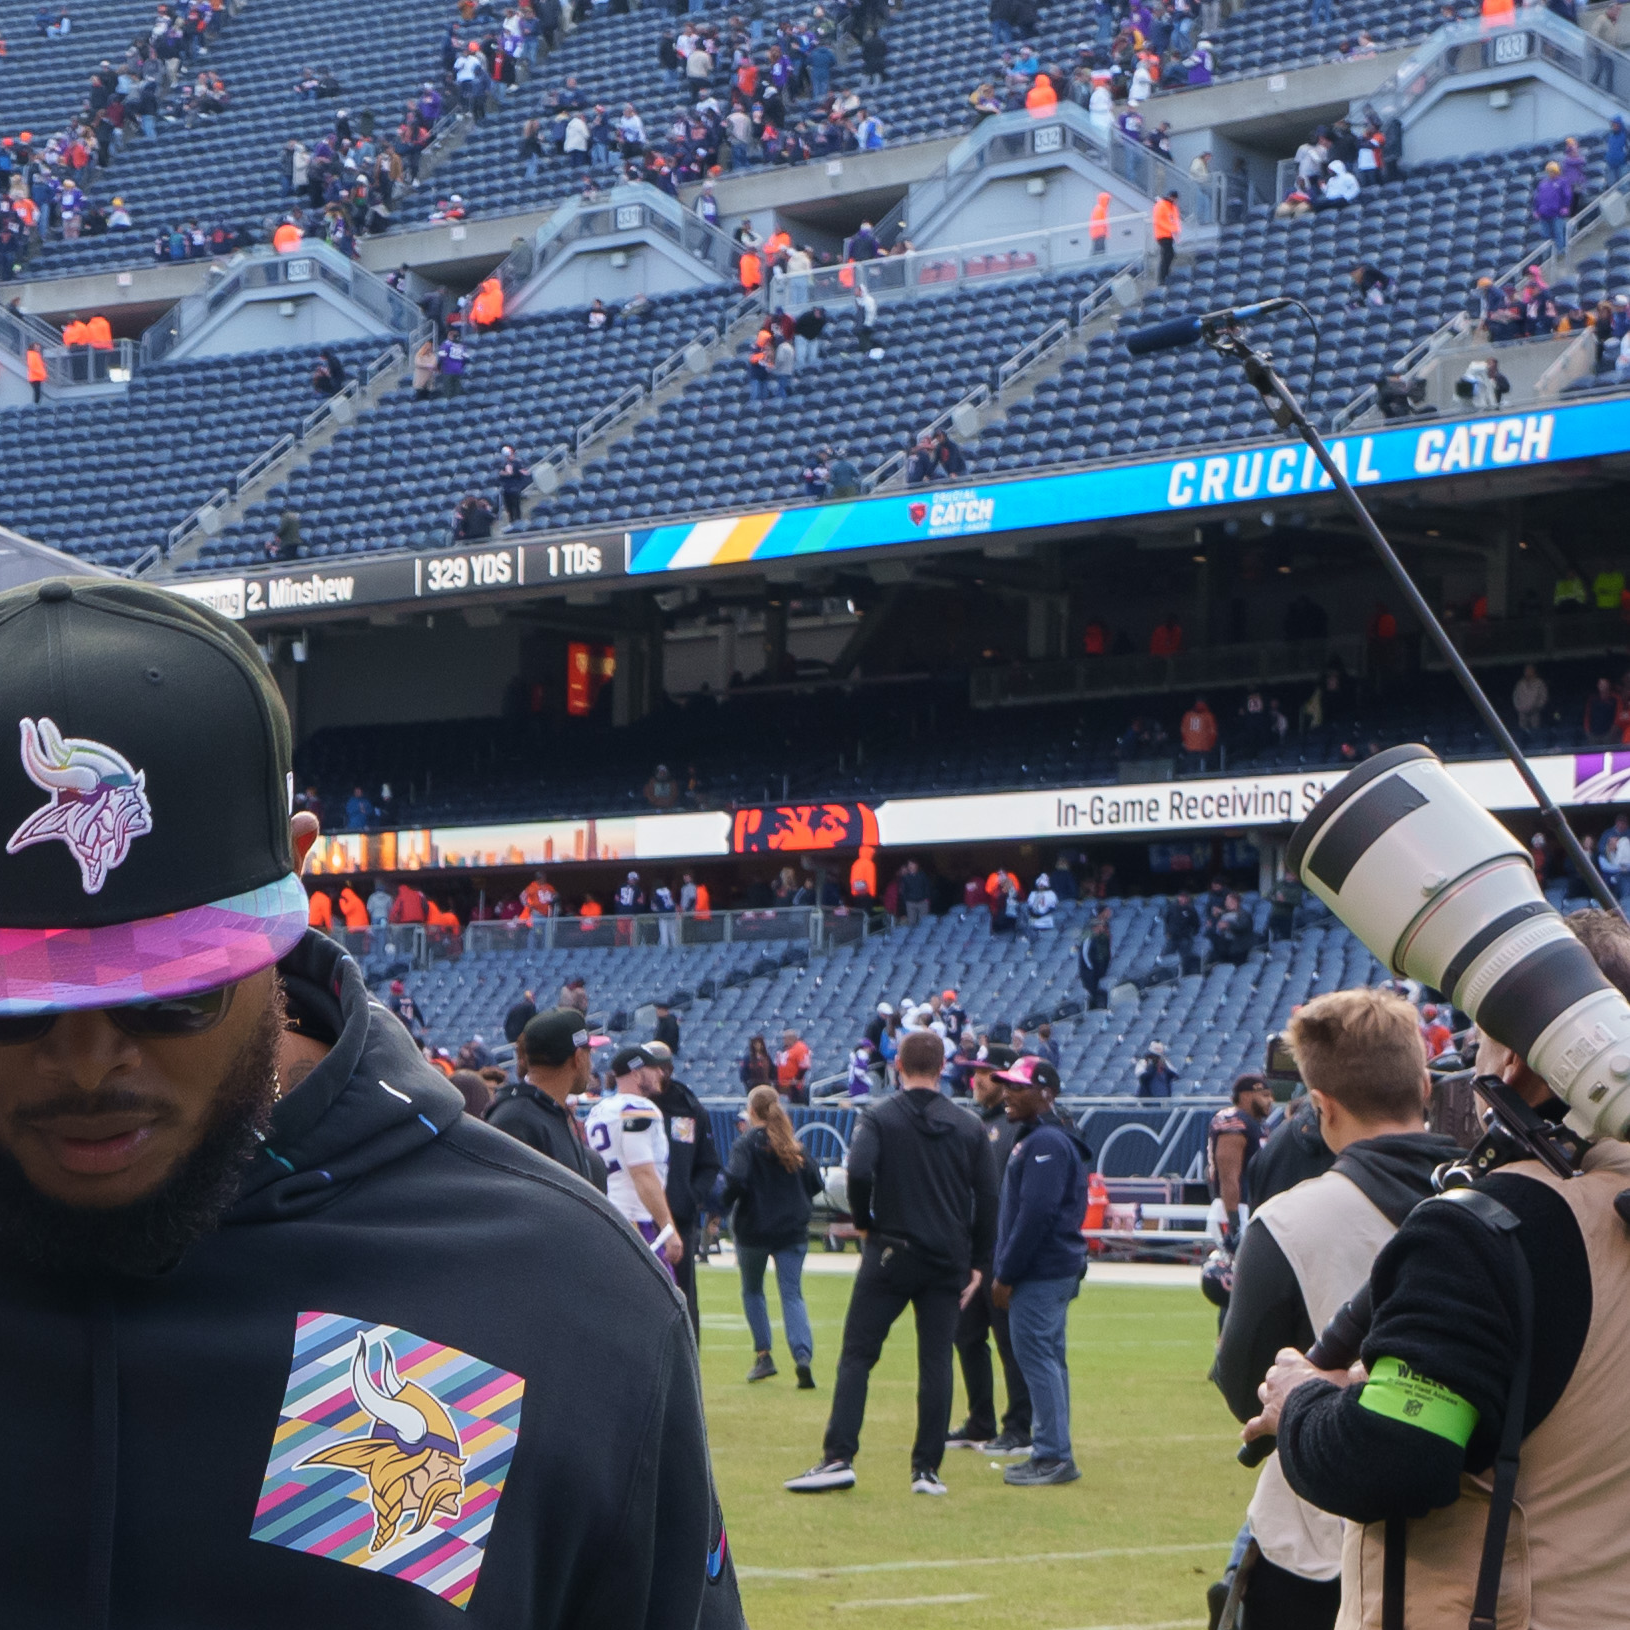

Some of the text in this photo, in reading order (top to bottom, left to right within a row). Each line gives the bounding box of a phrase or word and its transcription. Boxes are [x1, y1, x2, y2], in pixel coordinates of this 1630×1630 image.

[1167, 413, 1555, 506] CRUCIAL CATCH
[929, 498, 995, 526] CATCH
[427, 554, 512, 592] 329 YDS
[547, 542, 602, 576] 1 TDs
[246, 573, 355, 611] 2. Minshew
[1056, 795, 1160, 828] In-Game
[1169, 783, 1293, 821] Receiving
